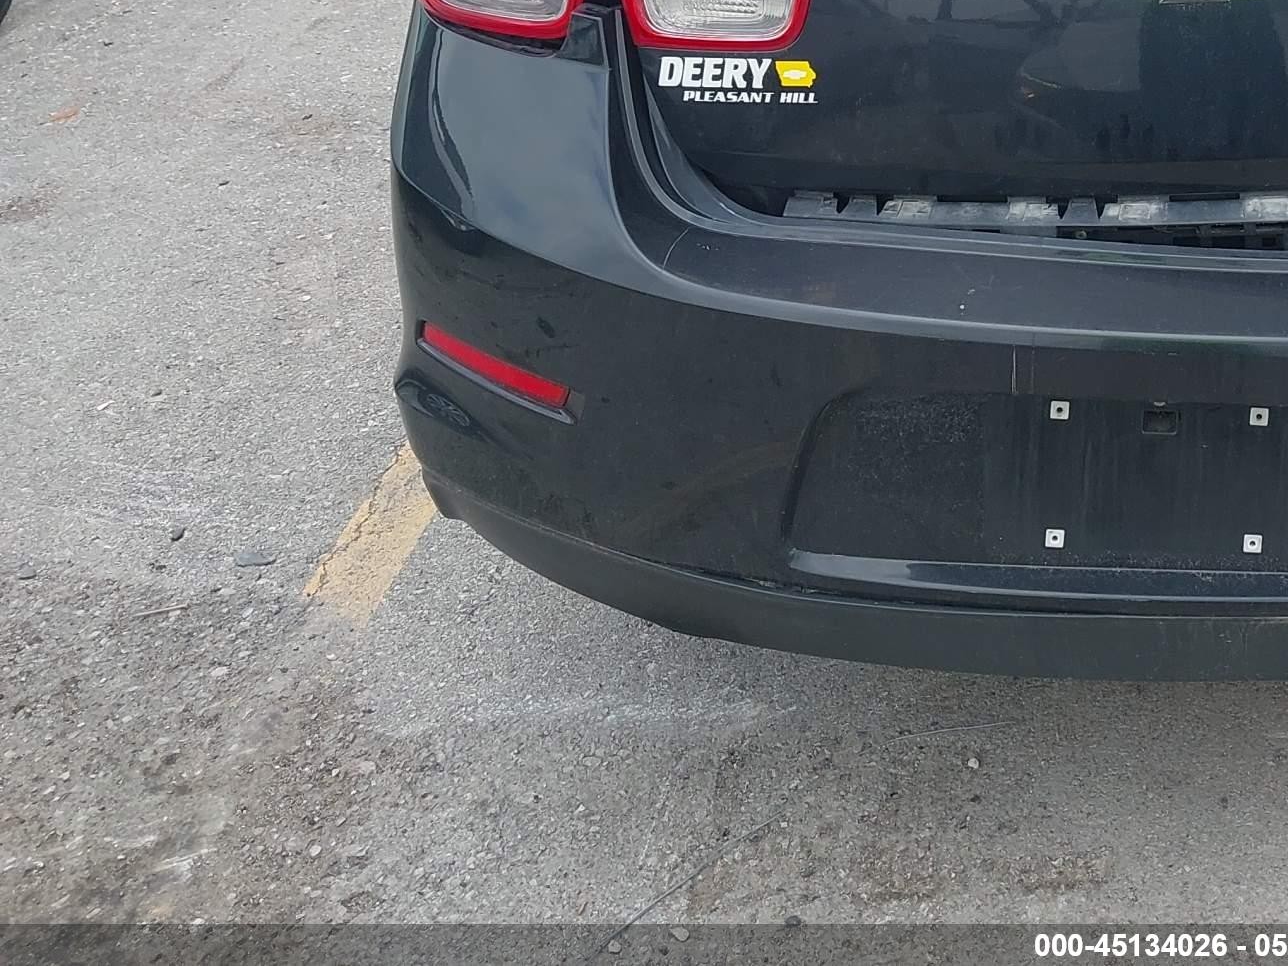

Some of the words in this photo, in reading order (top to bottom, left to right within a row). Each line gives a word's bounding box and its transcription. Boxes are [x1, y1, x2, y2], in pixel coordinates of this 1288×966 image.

[658, 56, 773, 89] DEERY
[683, 90, 775, 103] PLEASANT
[779, 92, 818, 104] HILL
